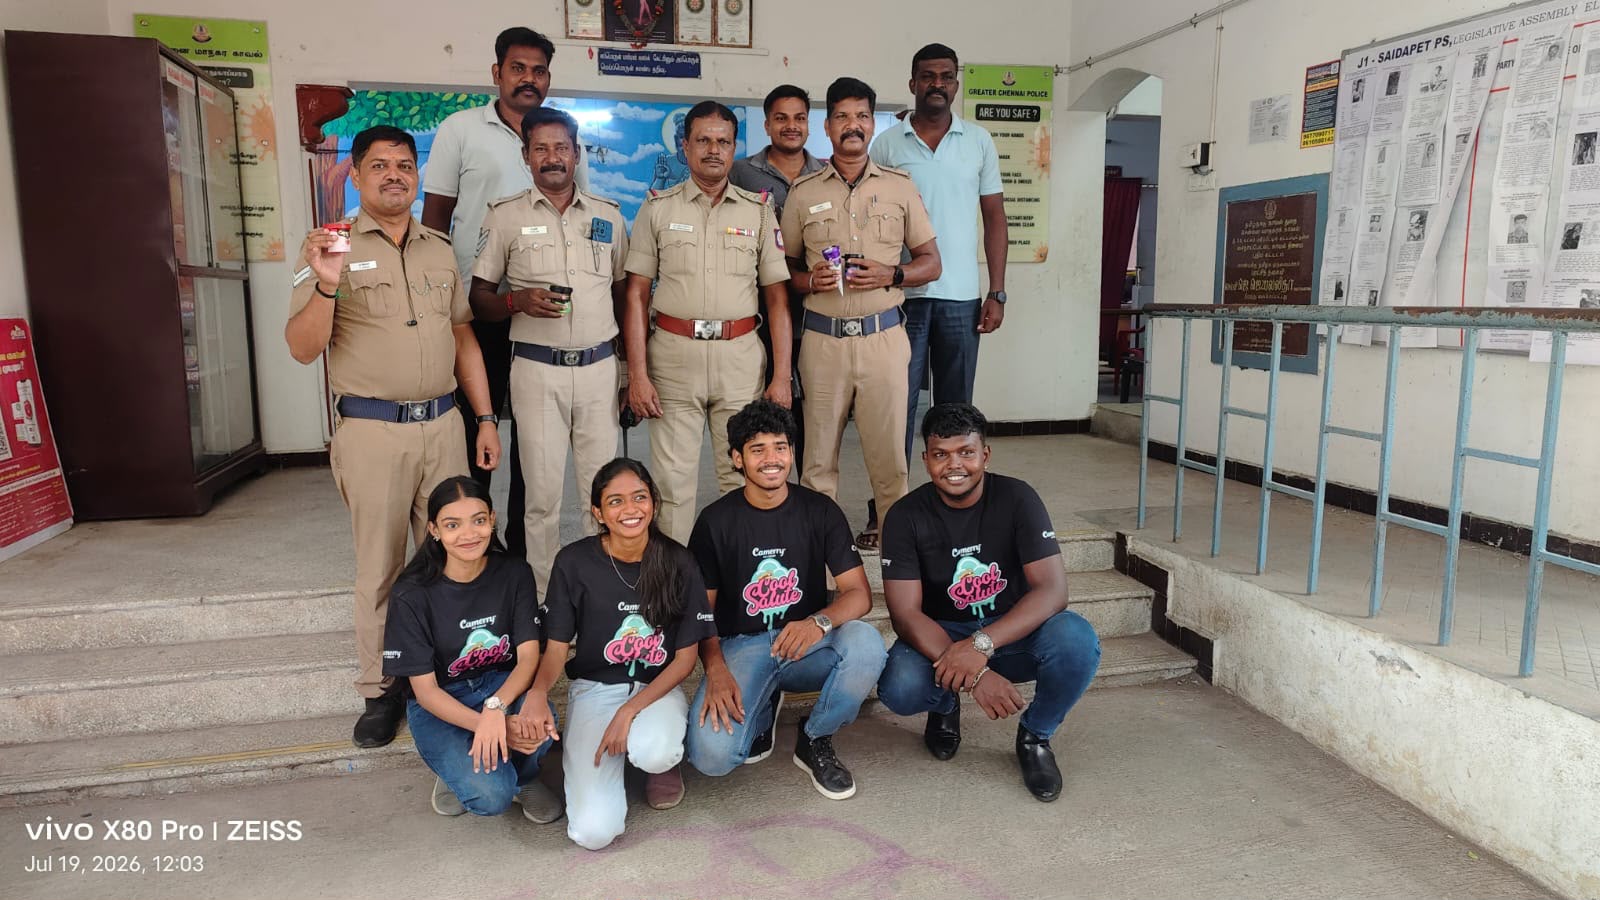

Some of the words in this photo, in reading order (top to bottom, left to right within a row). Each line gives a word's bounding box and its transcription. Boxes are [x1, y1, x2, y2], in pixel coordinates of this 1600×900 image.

[1357, 57, 1369, 69] J1
[1378, 40, 1432, 64] SAIDAPET
[1453, 20, 1516, 45] LEGISLATIVE
[1519, 5, 1577, 27] ASSEMBLY
[1584, 1, 1600, 12] EL
[1496, 59, 1515, 71] PARTY
[968, 88, 996, 96] GREATER
[998, 89, 1025, 97] CHENNAI
[1026, 90, 1048, 98] POLICE
[979, 107, 994, 118] ARE
[995, 108, 1011, 118] YOU
[1012, 108, 1031, 119] SAFE
[752, 547, 787, 557] Camerry
[757, 569, 798, 597] Cool
[743, 583, 802, 616] Salute
[459, 615, 497, 629] Camerry
